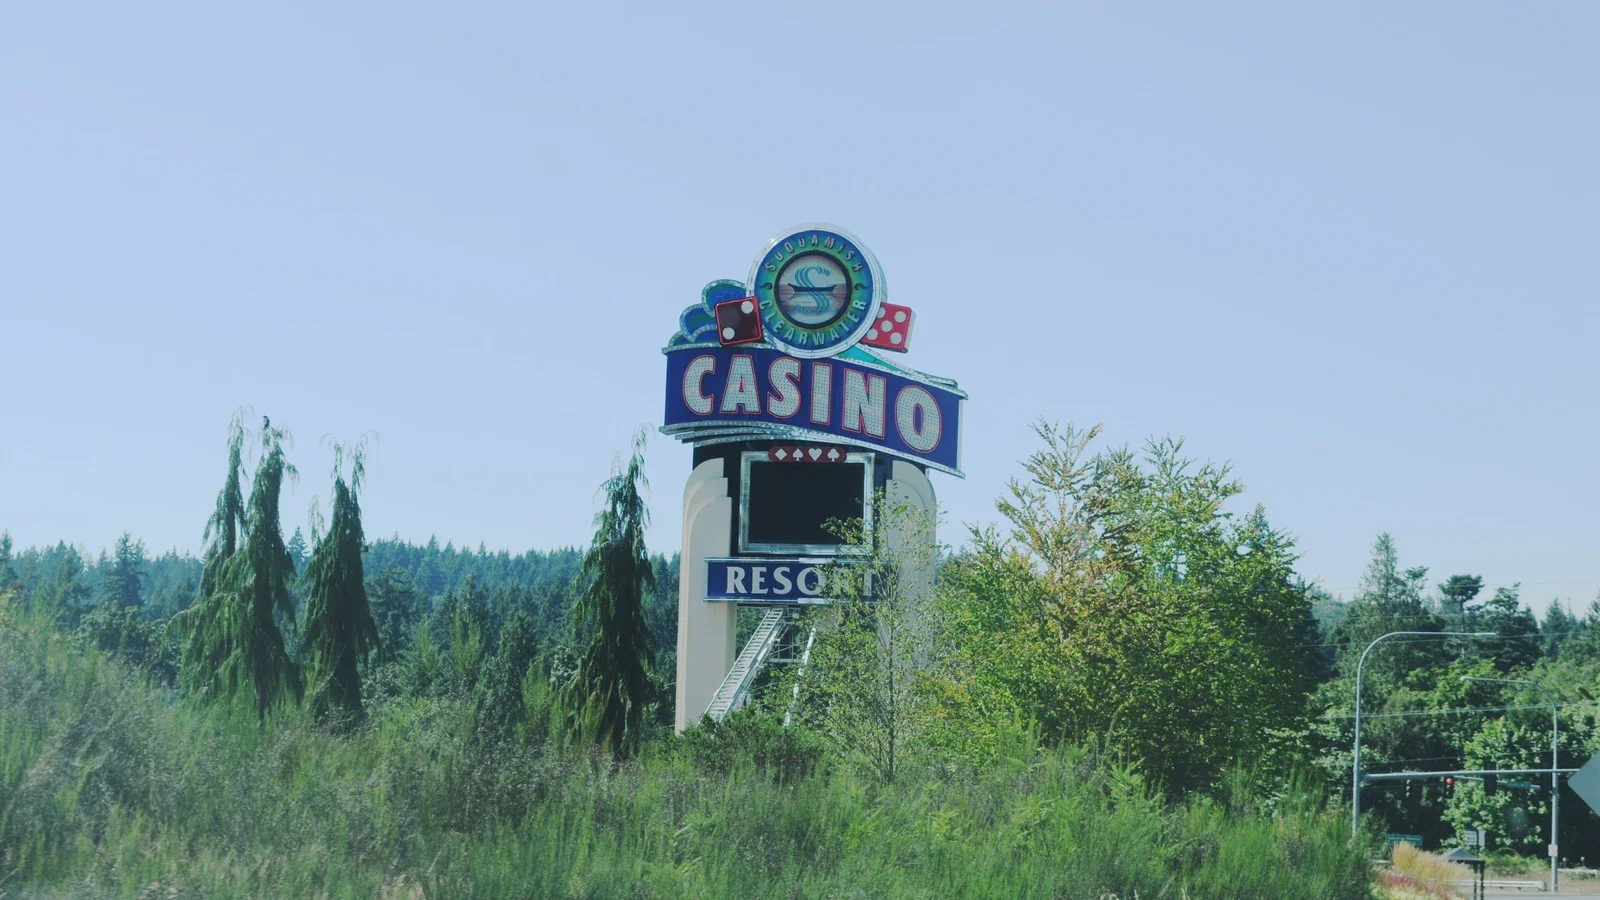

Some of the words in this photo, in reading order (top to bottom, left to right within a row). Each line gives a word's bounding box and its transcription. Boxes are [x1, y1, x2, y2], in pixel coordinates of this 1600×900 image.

[764, 234, 864, 272] SUQUAMISH
[759, 299, 868, 346] CLEARWATER
[682, 354, 942, 453] CASINO
